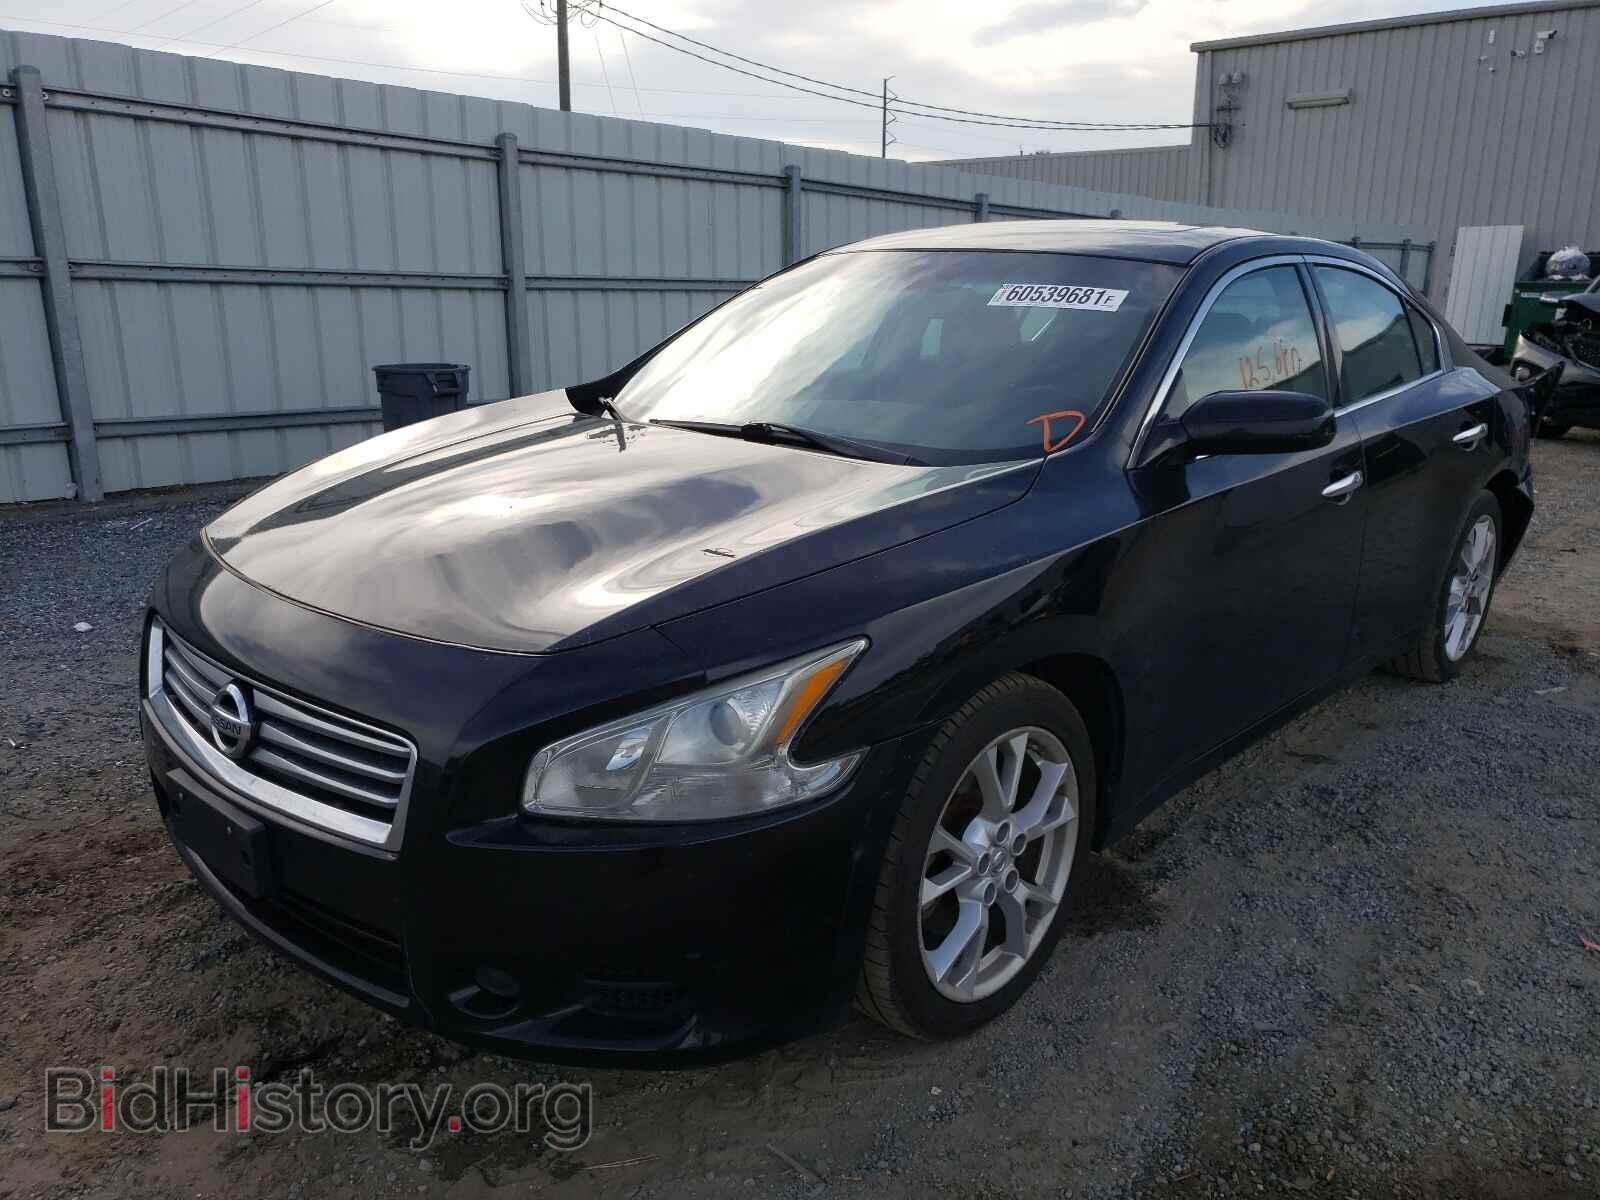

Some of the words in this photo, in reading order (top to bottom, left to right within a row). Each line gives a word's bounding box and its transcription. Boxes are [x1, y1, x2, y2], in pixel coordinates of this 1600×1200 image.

[1006, 285, 1106, 305] 60539681
[1025, 410, 1086, 453] D
[210, 716, 242, 736] SSAN
